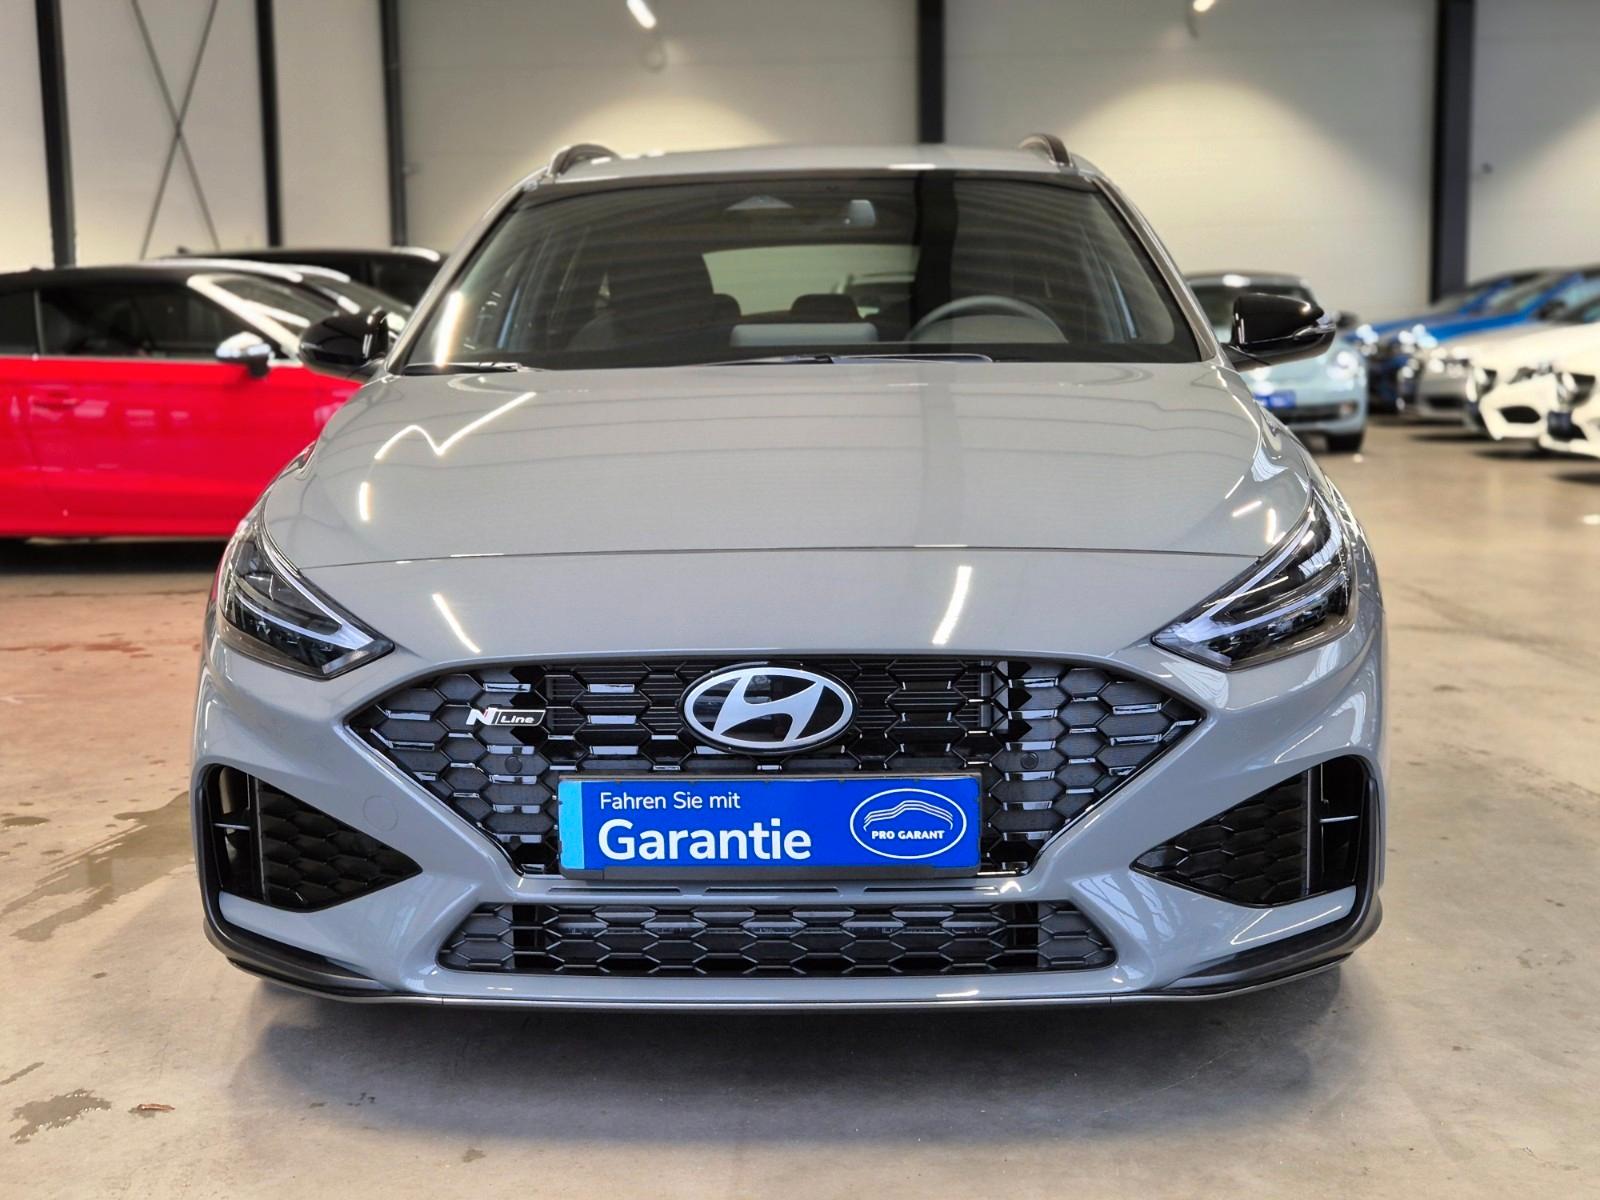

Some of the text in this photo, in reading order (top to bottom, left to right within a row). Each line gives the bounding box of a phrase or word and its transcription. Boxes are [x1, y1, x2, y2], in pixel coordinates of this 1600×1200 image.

[500, 715, 535, 724] Line
[599, 791, 741, 810] Fahren Sie mit
[598, 817, 812, 861] Garantie
[871, 829, 946, 840] PRO GARANT
